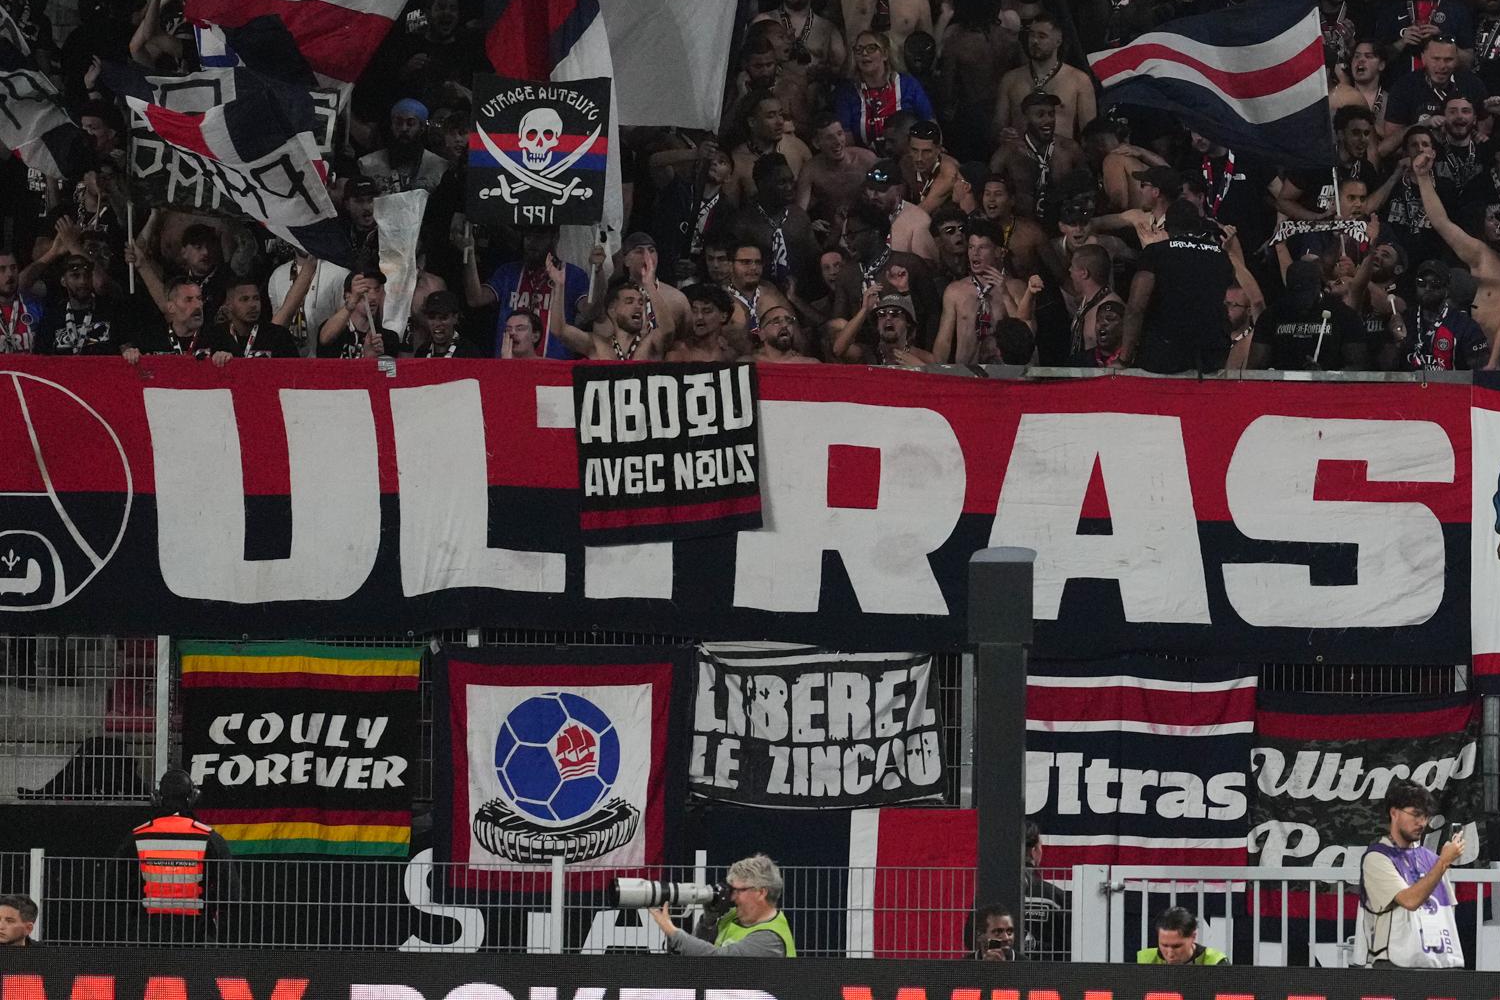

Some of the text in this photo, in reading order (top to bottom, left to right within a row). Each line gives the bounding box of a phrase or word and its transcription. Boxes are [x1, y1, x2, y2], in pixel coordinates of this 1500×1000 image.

[513, 205, 555, 225] 1991
[509, 291, 551, 311] PARI
[580, 364, 756, 444] ABDOU
[584, 442, 757, 498] AVEC NOUS
[142, 378, 1456, 630] ULRAS
[693, 656, 937, 744] LIBEREZ
[208, 711, 389, 749] COULY
[189, 750, 409, 790] FOREVER
[688, 733, 742, 791] LE
[1249, 740, 1478, 803] Ultras
[1246, 818, 1481, 886] Pais
